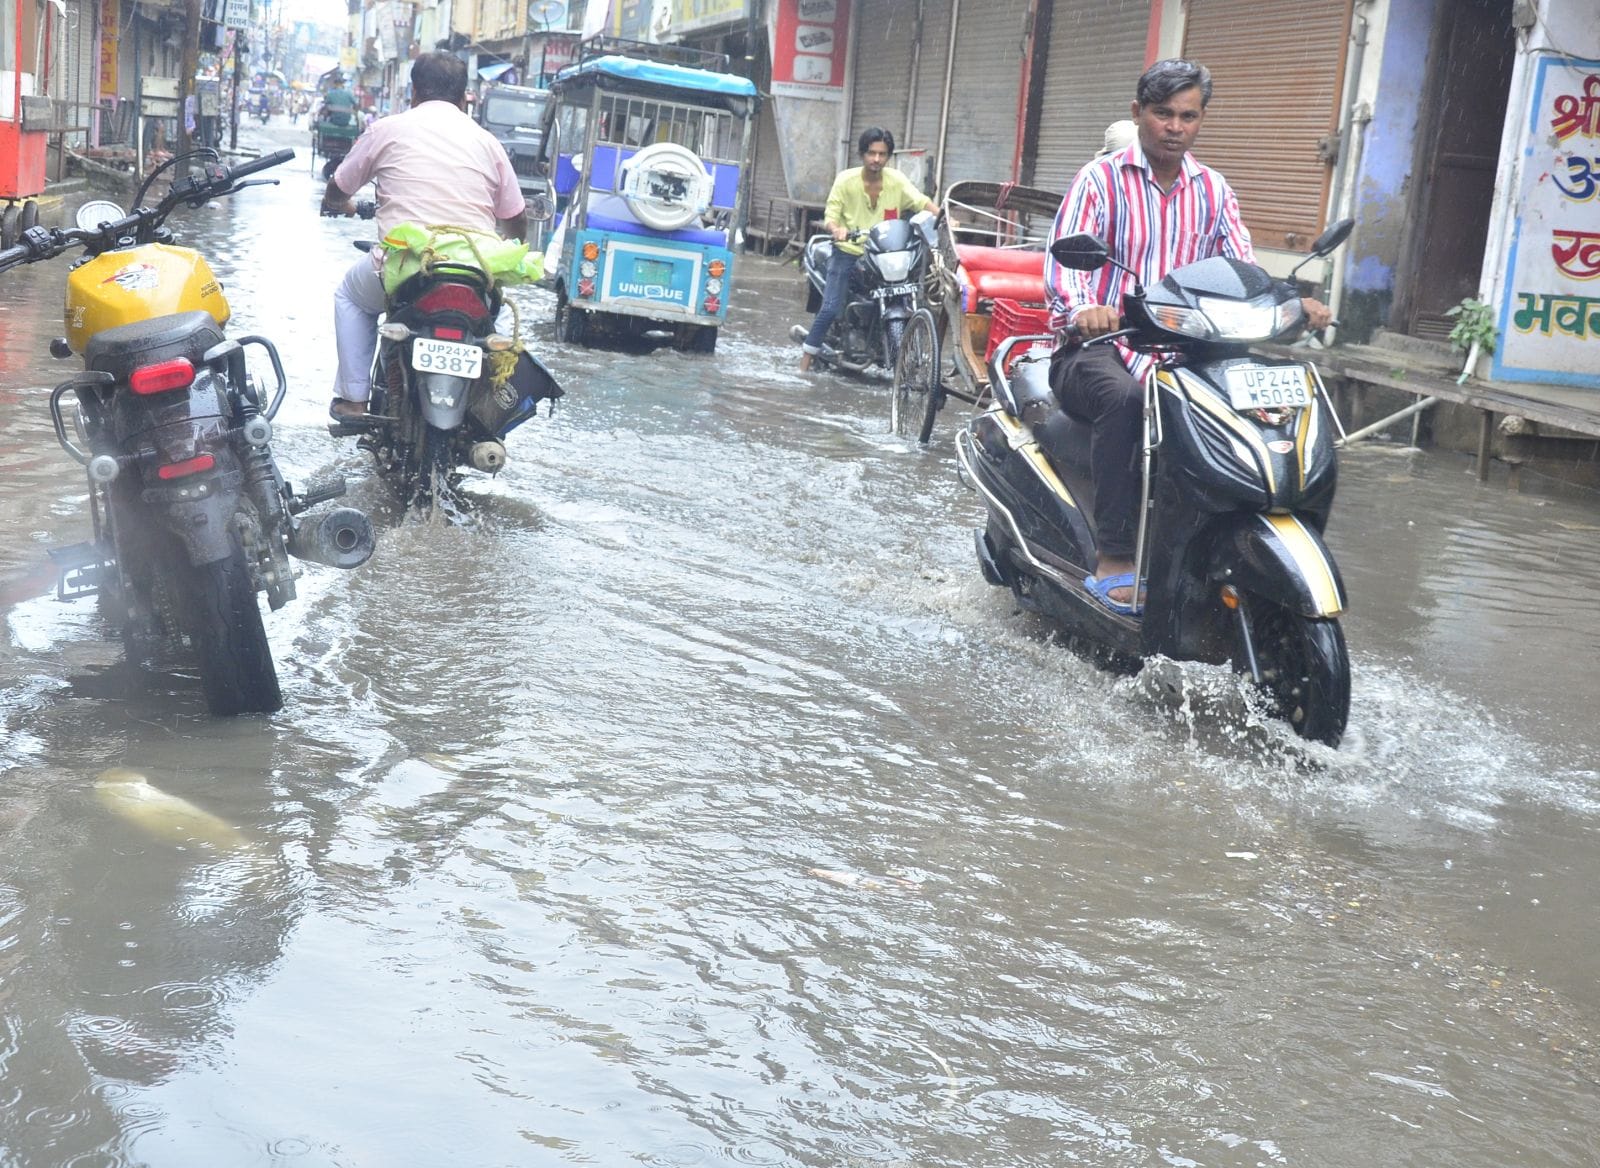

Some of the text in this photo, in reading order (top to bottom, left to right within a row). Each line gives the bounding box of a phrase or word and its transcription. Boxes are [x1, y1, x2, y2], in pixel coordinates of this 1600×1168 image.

[427, 343, 470, 357] UP24X
[419, 353, 478, 374] 9387
[1244, 370, 1302, 388] UP24A
